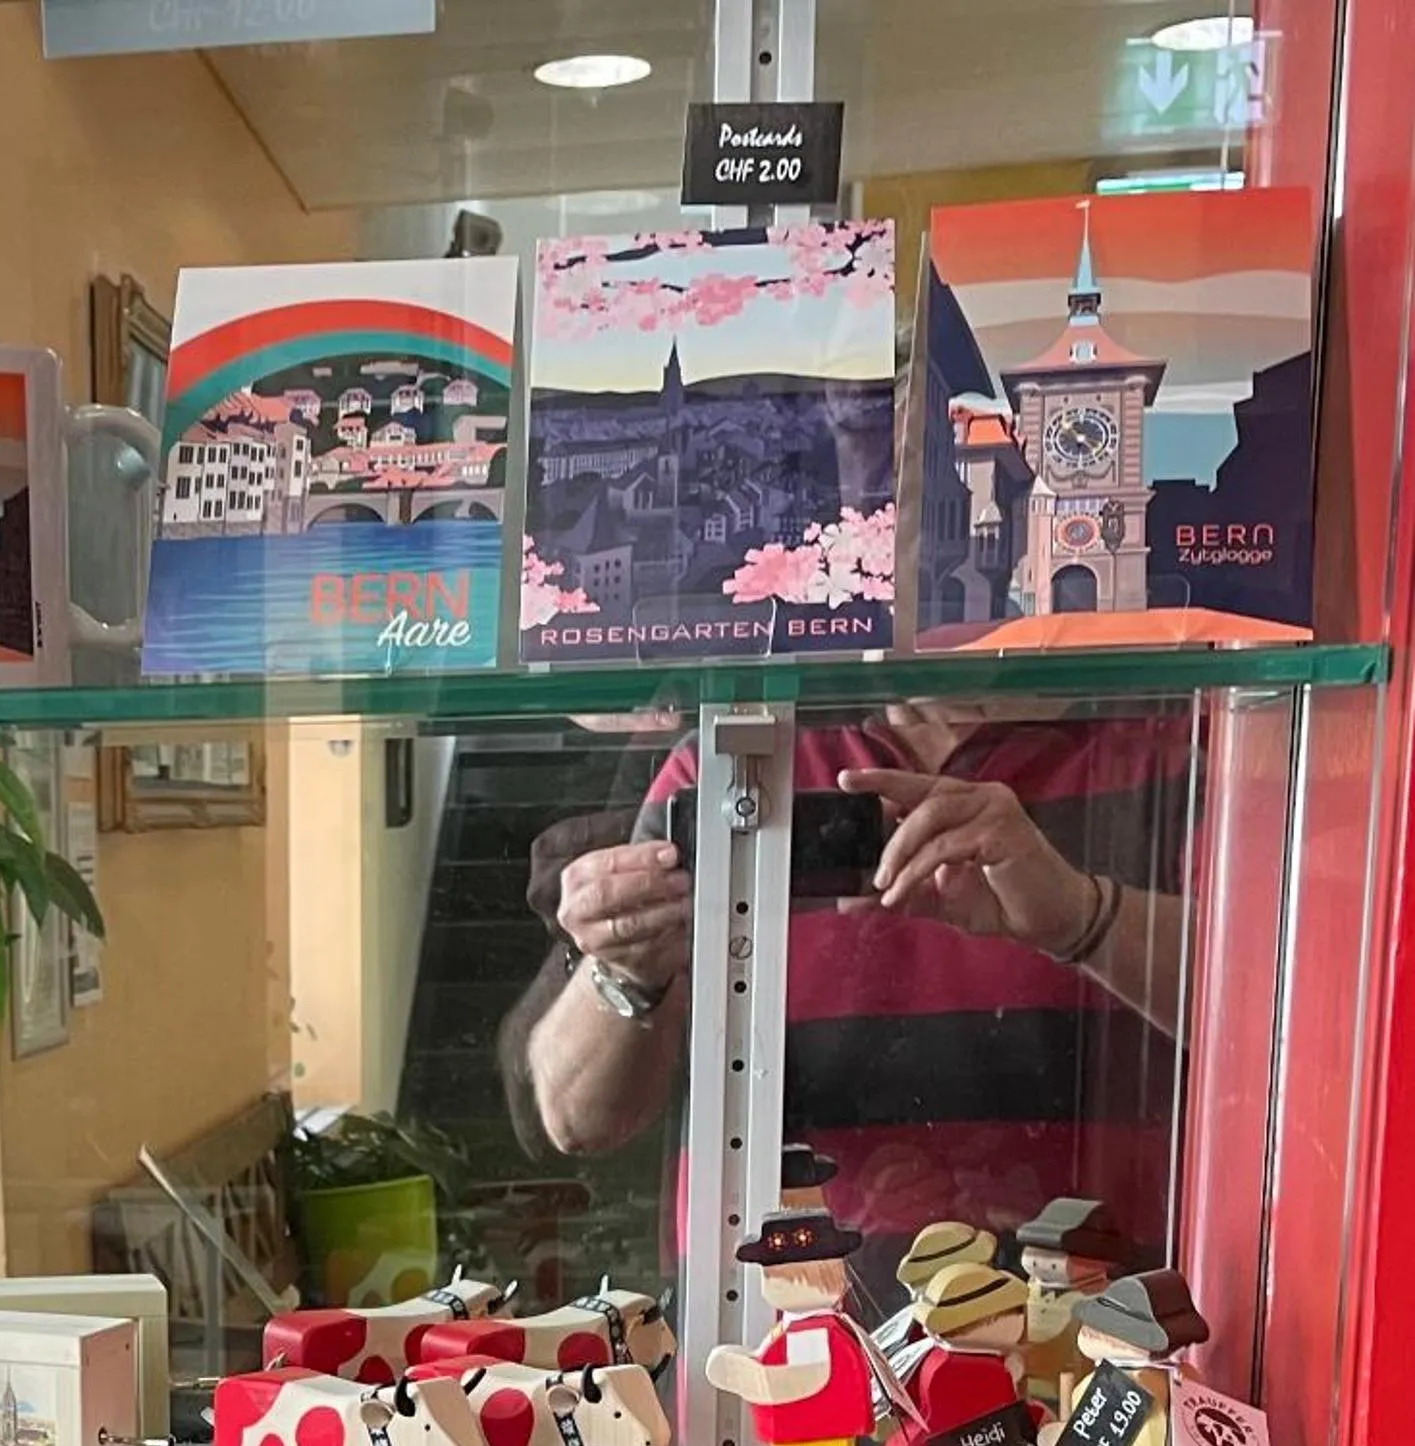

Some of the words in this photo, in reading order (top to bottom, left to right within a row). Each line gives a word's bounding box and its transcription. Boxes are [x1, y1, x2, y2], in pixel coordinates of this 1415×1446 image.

[719, 122, 803, 149] Postcards
[715, 157, 754, 183] CHF
[759, 157, 801, 182] 2.00
[1176, 523, 1274, 546] BERN
[311, 571, 471, 625] BERN
[377, 609, 472, 647] Aare
[541, 620, 773, 645] ROSENGARTEN
[787, 616, 873, 636] BERN
[1073, 1386, 1108, 1440] Peter
[1109, 1390, 1142, 1438] 19.00
